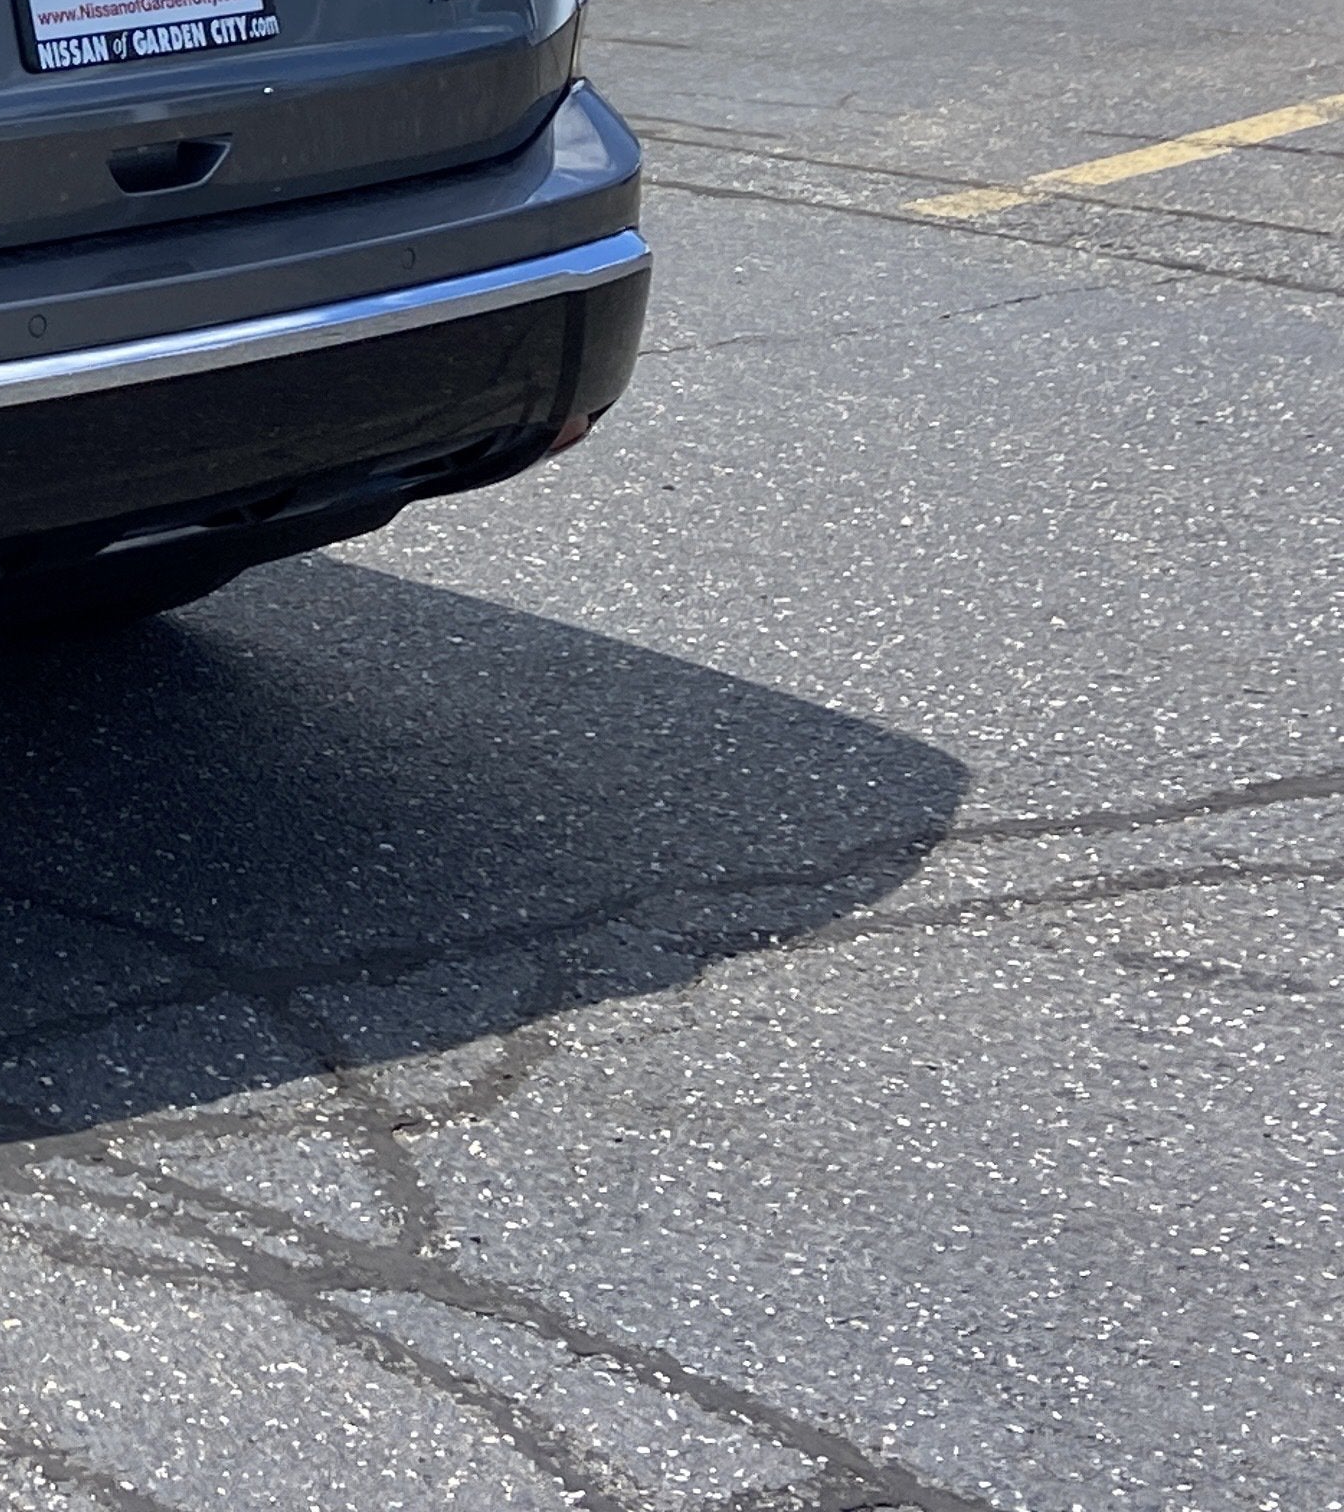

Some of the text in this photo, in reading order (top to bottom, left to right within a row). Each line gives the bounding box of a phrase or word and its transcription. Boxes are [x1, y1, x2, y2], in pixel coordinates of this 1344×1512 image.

[37, 32, 110, 70] NISSAN
[112, 31, 130, 60] of
[132, 23, 205, 56] GARDEN
